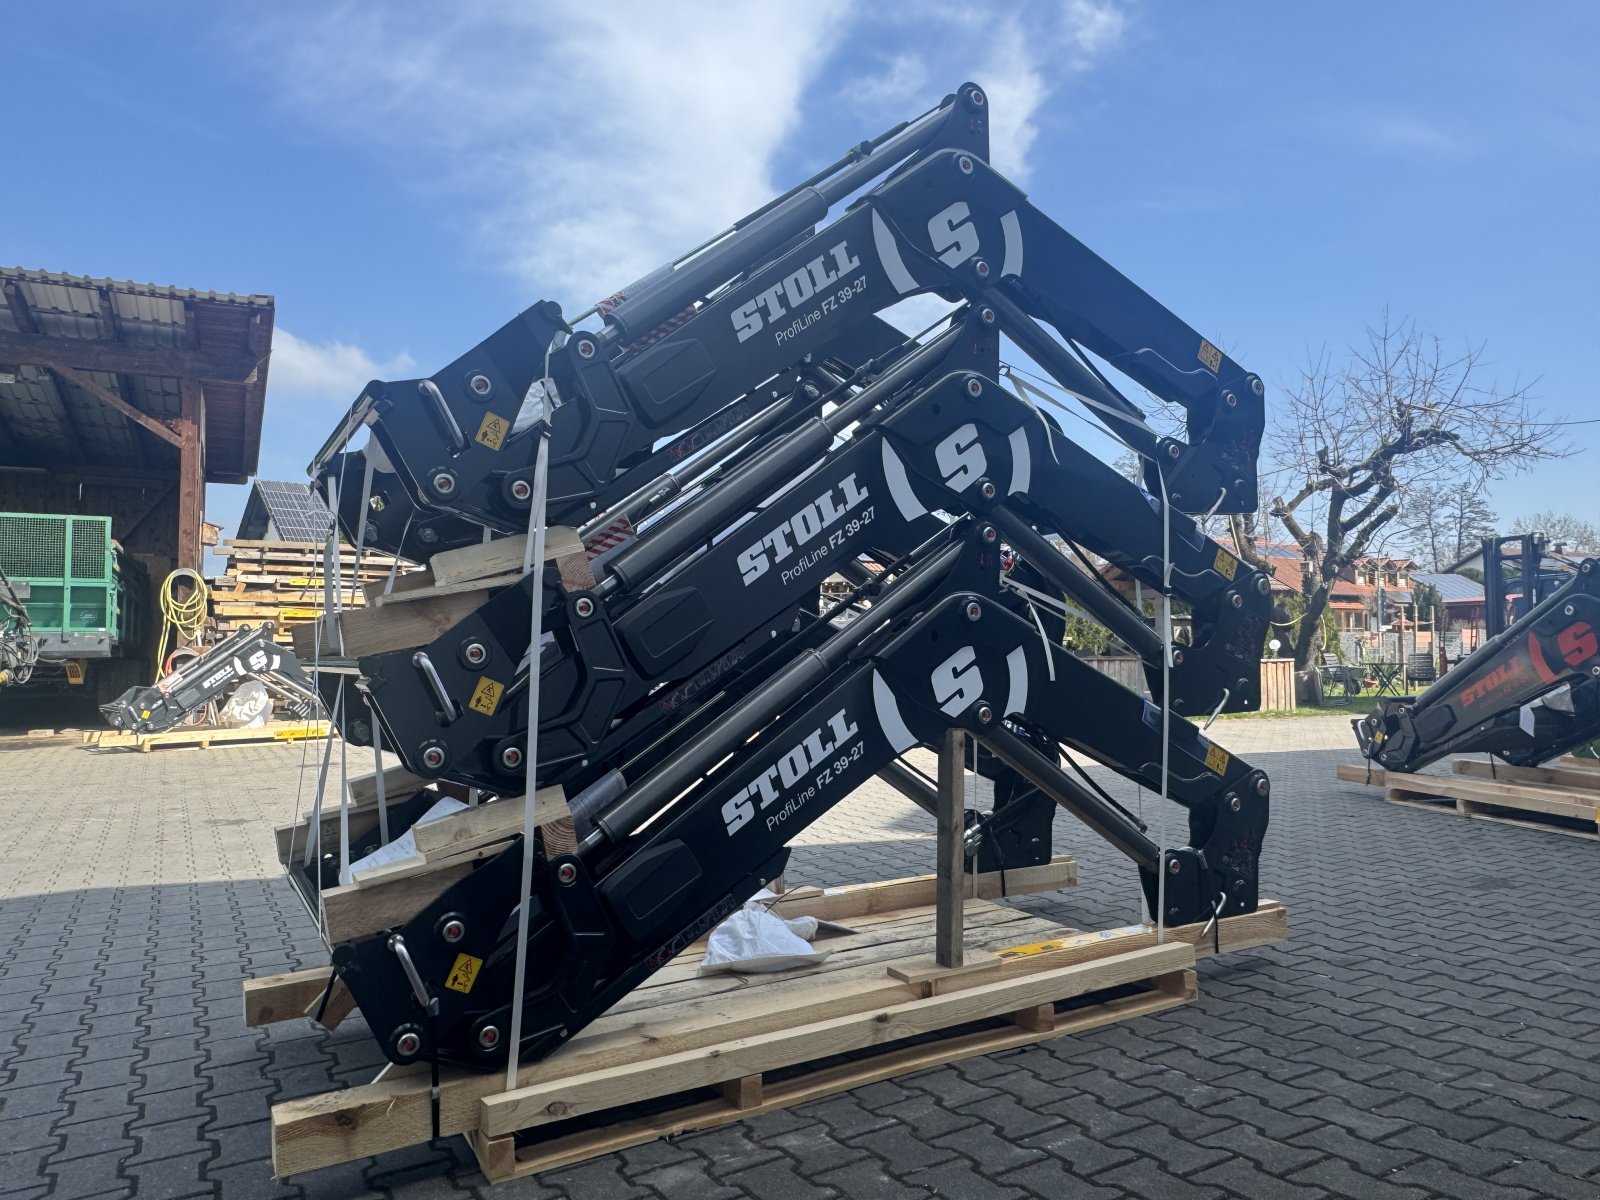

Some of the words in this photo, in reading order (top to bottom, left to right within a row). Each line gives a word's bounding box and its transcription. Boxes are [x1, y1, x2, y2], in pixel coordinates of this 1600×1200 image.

[927, 201, 980, 270] S
[730, 240, 861, 344] STOLL
[775, 309, 822, 347] ProfiLine
[822, 299, 838, 316] FZ
[837, 275, 868, 305] 39-27
[934, 423, 987, 493] S
[736, 472, 869, 587] STOLL
[781, 544, 829, 586] ProfiLine
[828, 532, 846, 550] FZ
[845, 506, 876, 537] 39-27
[1556, 621, 1599, 666] S
[930, 645, 984, 719] S
[1459, 656, 1526, 708] STOLL
[721, 708, 859, 837] STOLL
[766, 786, 816, 832] ProfiLine
[816, 773, 834, 791] FZ
[833, 741, 865, 774] 39-27
